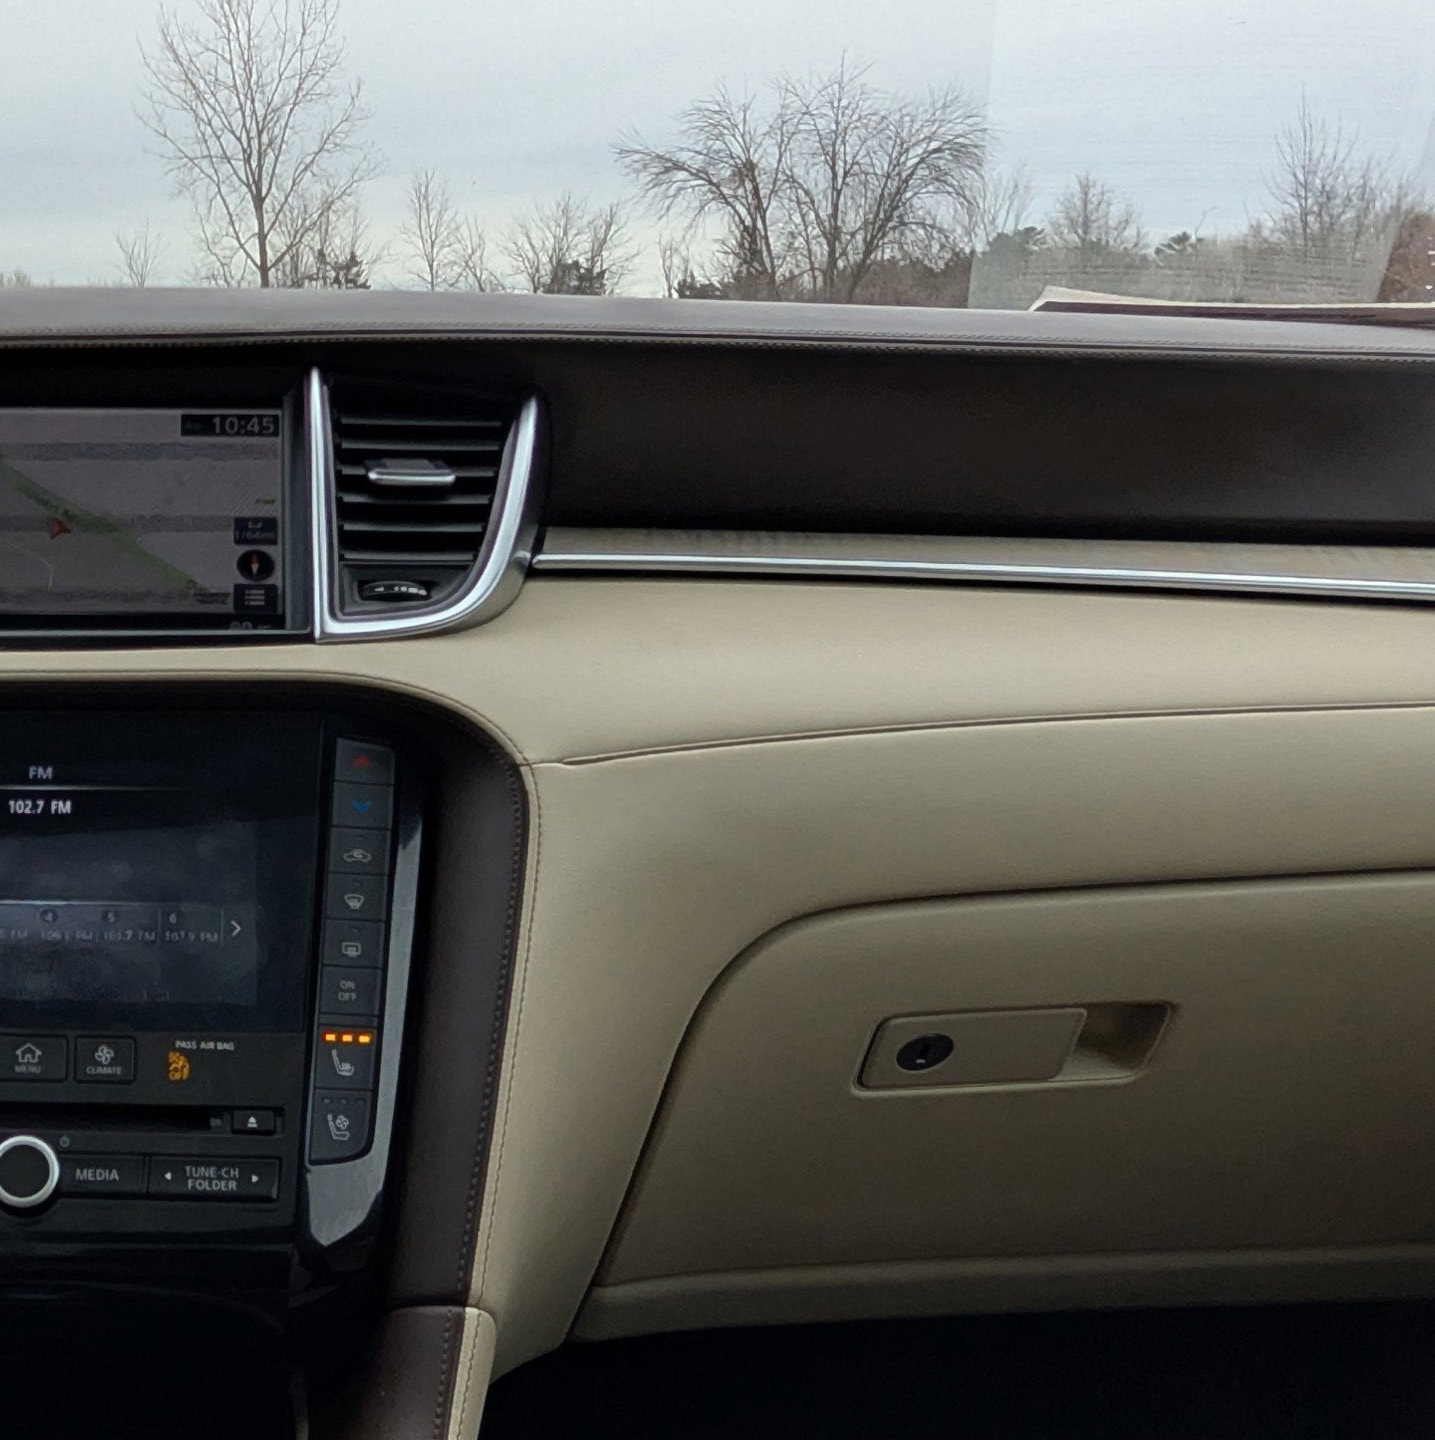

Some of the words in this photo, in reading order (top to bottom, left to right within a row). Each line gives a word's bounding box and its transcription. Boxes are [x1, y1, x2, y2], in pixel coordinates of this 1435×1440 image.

[212, 417, 275, 434] 10:45
[28, 766, 53, 779] FM
[8, 799, 45, 814] 102.7
[50, 799, 72, 814] FM
[169, 913, 178, 924] 6
[10, 928, 28, 939] FM
[75, 930, 93, 941] FM
[138, 931, 156, 941] FM
[200, 931, 219, 943] FM
[175, 1040, 197, 1050] PASS
[199, 1041, 215, 1050] AIR
[217, 1042, 235, 1051] BAG
[14, 1064, 42, 1075] MENU
[86, 1065, 123, 1076] CLIMATE
[75, 1168, 120, 1181] MEDIA
[187, 1179, 238, 1191] FOLDER
